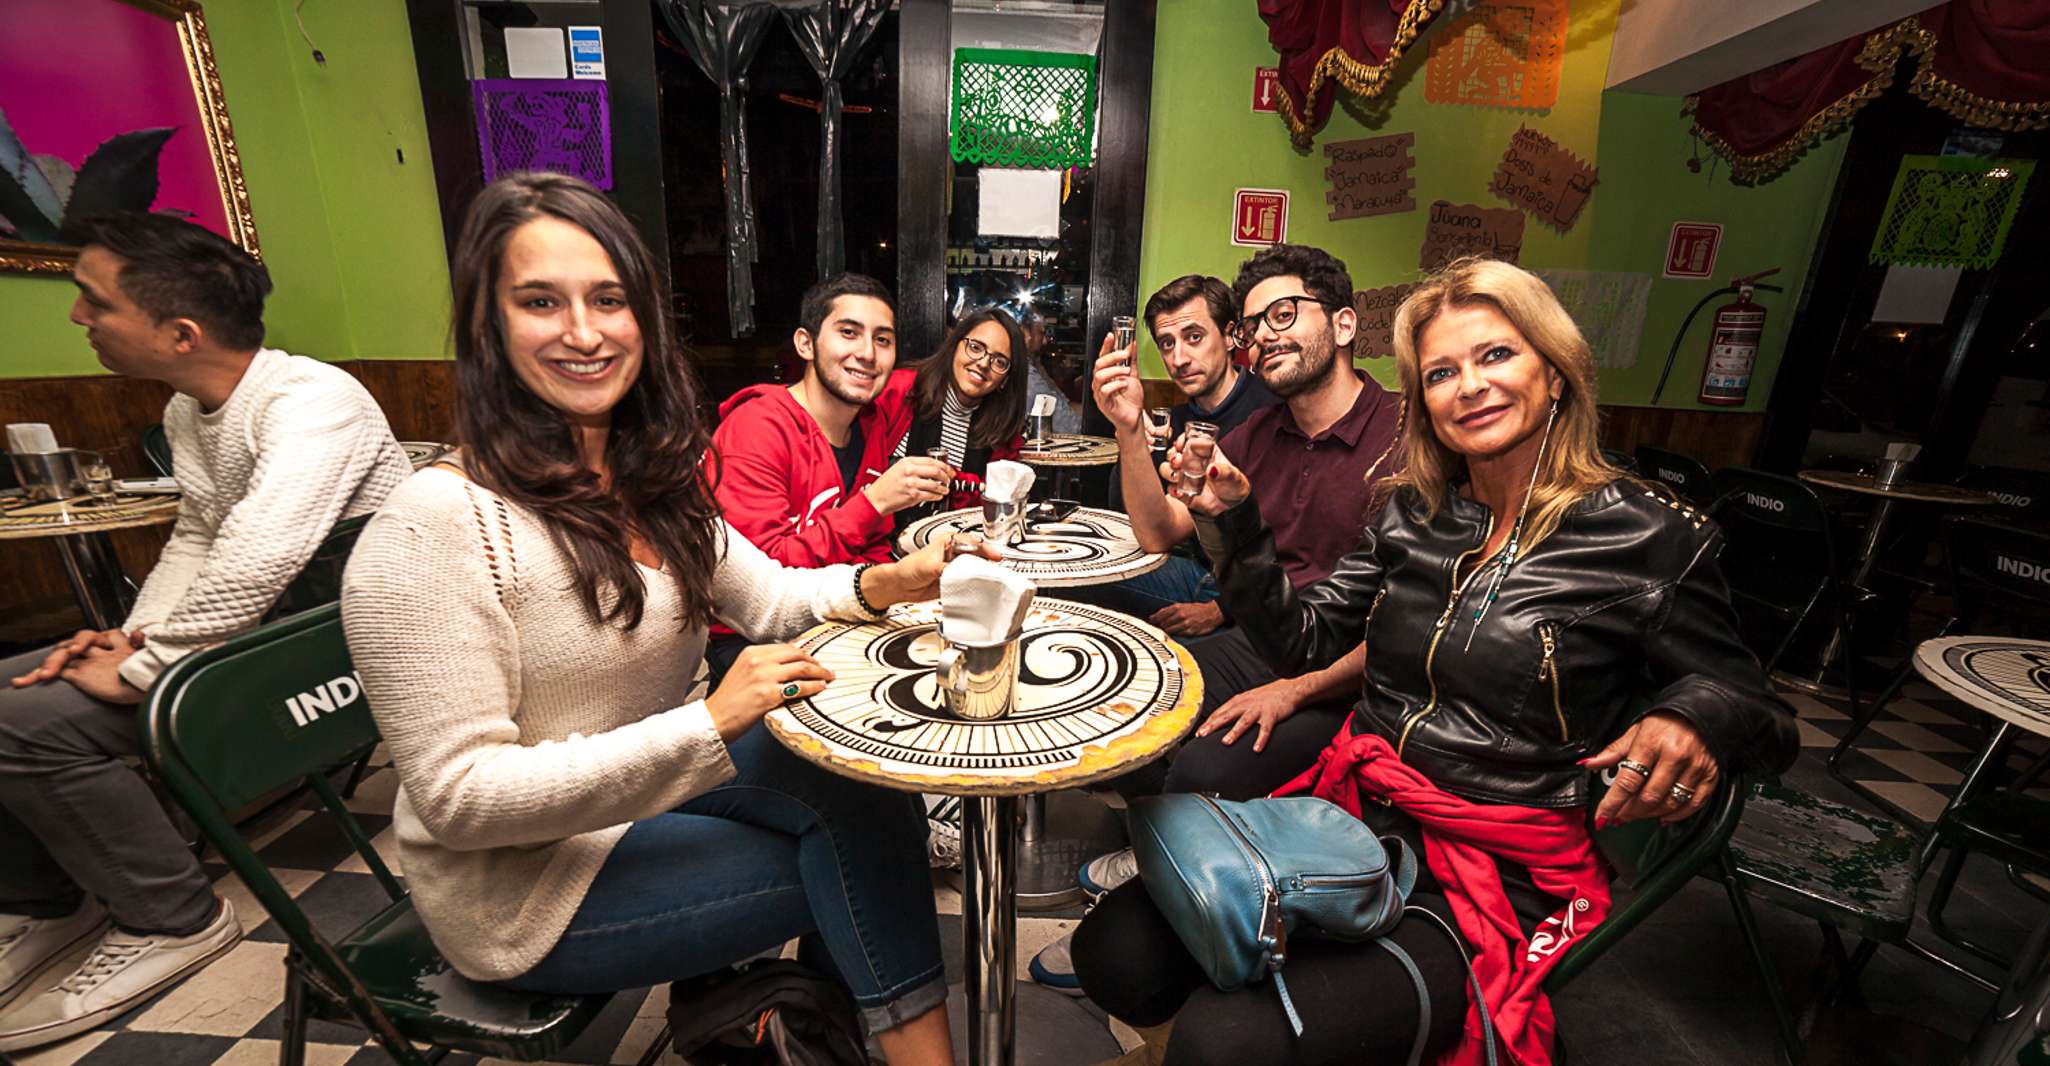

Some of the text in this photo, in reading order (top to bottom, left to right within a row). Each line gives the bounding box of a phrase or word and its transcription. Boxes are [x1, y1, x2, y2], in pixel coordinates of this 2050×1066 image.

[1538, 170, 1552, 185] de
[1432, 203, 1481, 228] Juana
[1658, 467, 1685, 484] INDIO
[1747, 492, 1785, 512] INDIO
[285, 670, 368, 727] IND
